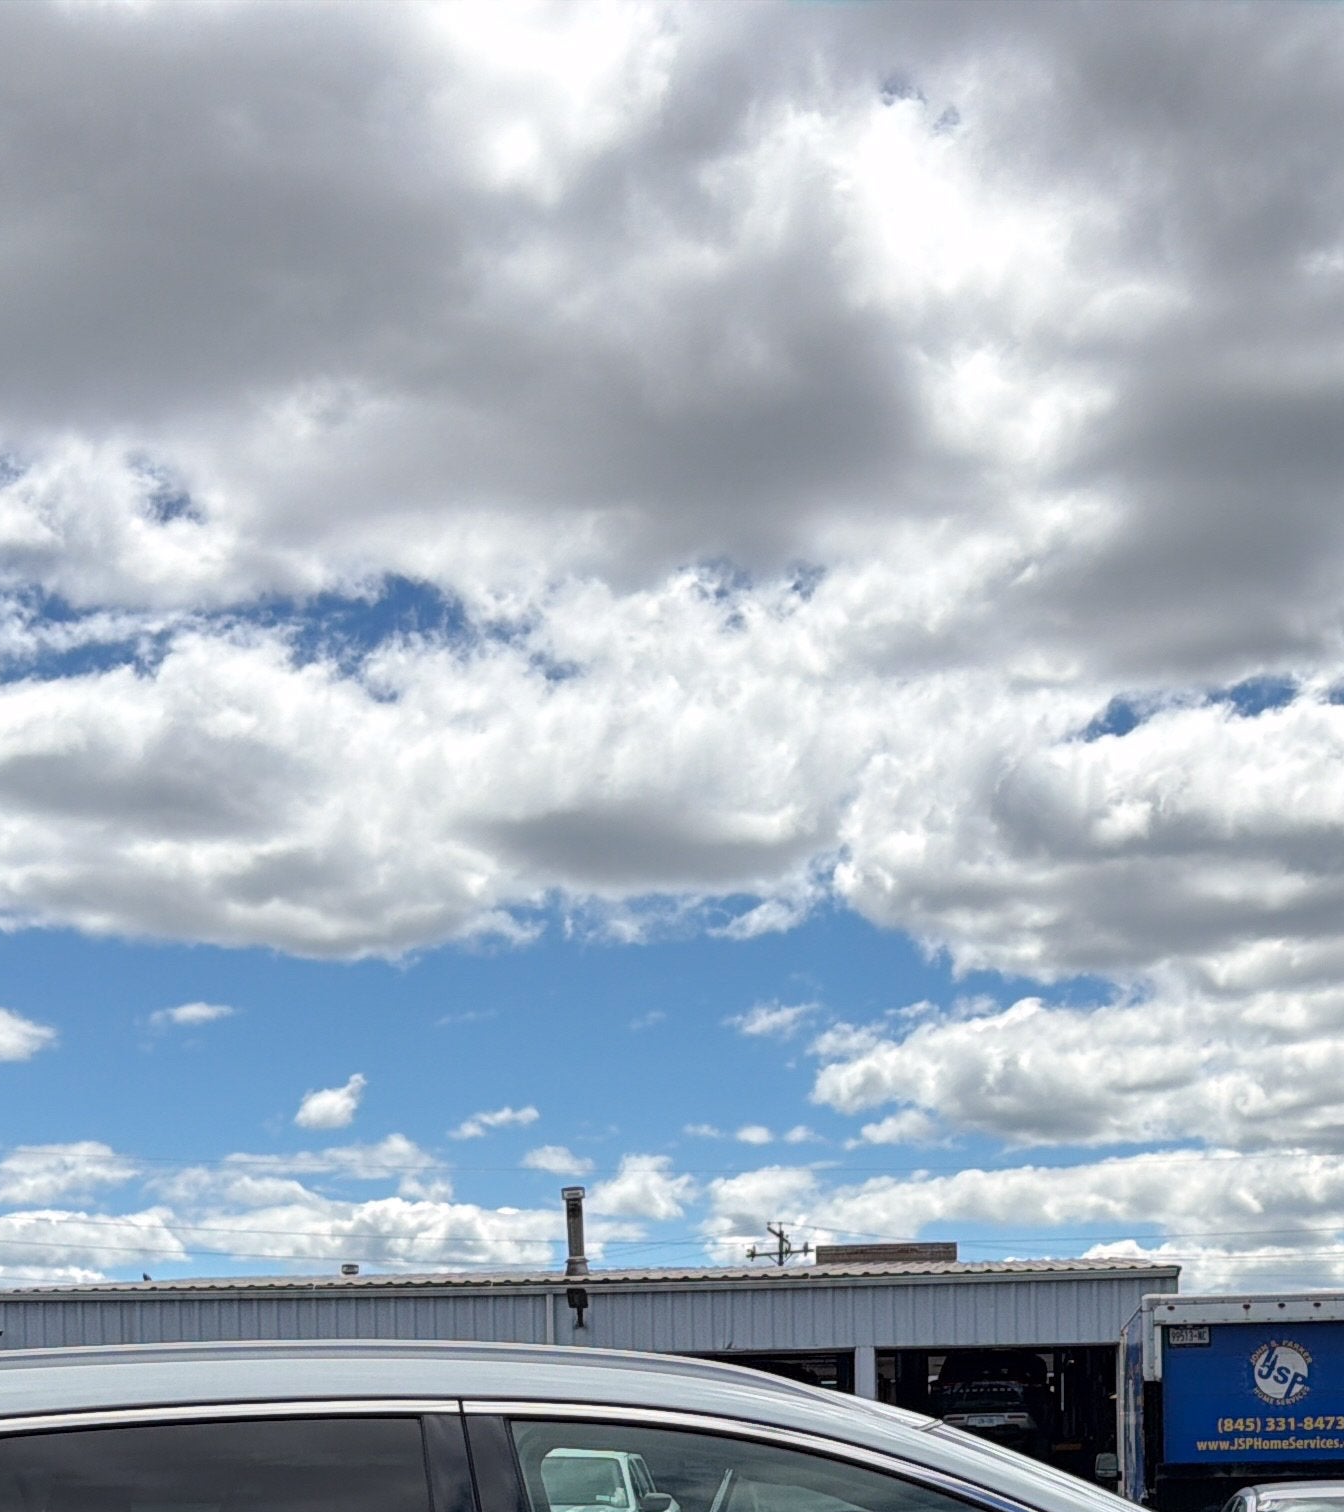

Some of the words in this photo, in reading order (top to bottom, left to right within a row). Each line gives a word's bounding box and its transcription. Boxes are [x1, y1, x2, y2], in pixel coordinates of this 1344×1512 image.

[1258, 1347, 1308, 1399] JSP
[1253, 1387, 1274, 1405] HOME
[1276, 1386, 1311, 1405] SERVICES
[1218, 1417, 1261, 1433] (845)
